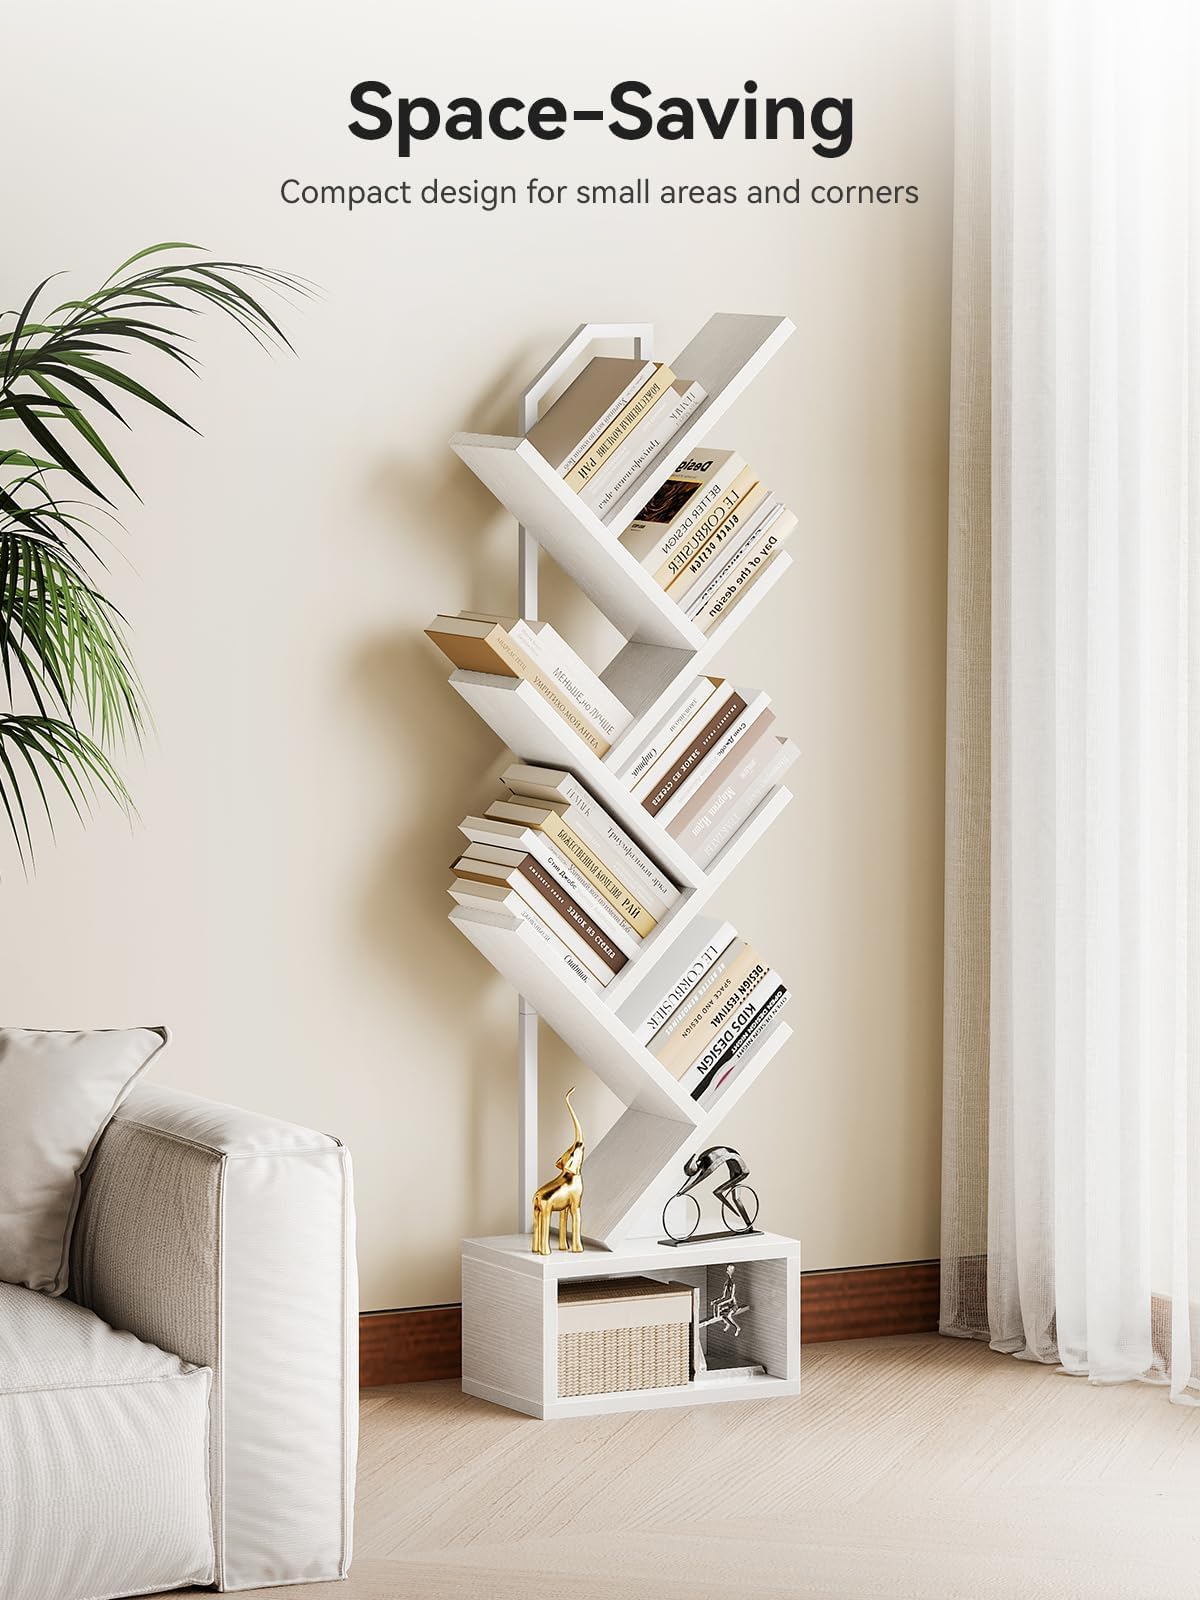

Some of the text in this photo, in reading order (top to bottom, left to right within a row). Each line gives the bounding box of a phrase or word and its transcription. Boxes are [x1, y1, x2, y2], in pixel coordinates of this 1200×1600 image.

[575, 456, 600, 481] РАЙ
[619, 895, 643, 919] РАЙ
[644, 944, 719, 1030] LE CORBUSIER
[680, 977, 732, 1039] SPACE AND DESIGN
[708, 963, 765, 1028] DESIGN FESTIVAL
[694, 1001, 758, 1075] KIDS DESIGN
